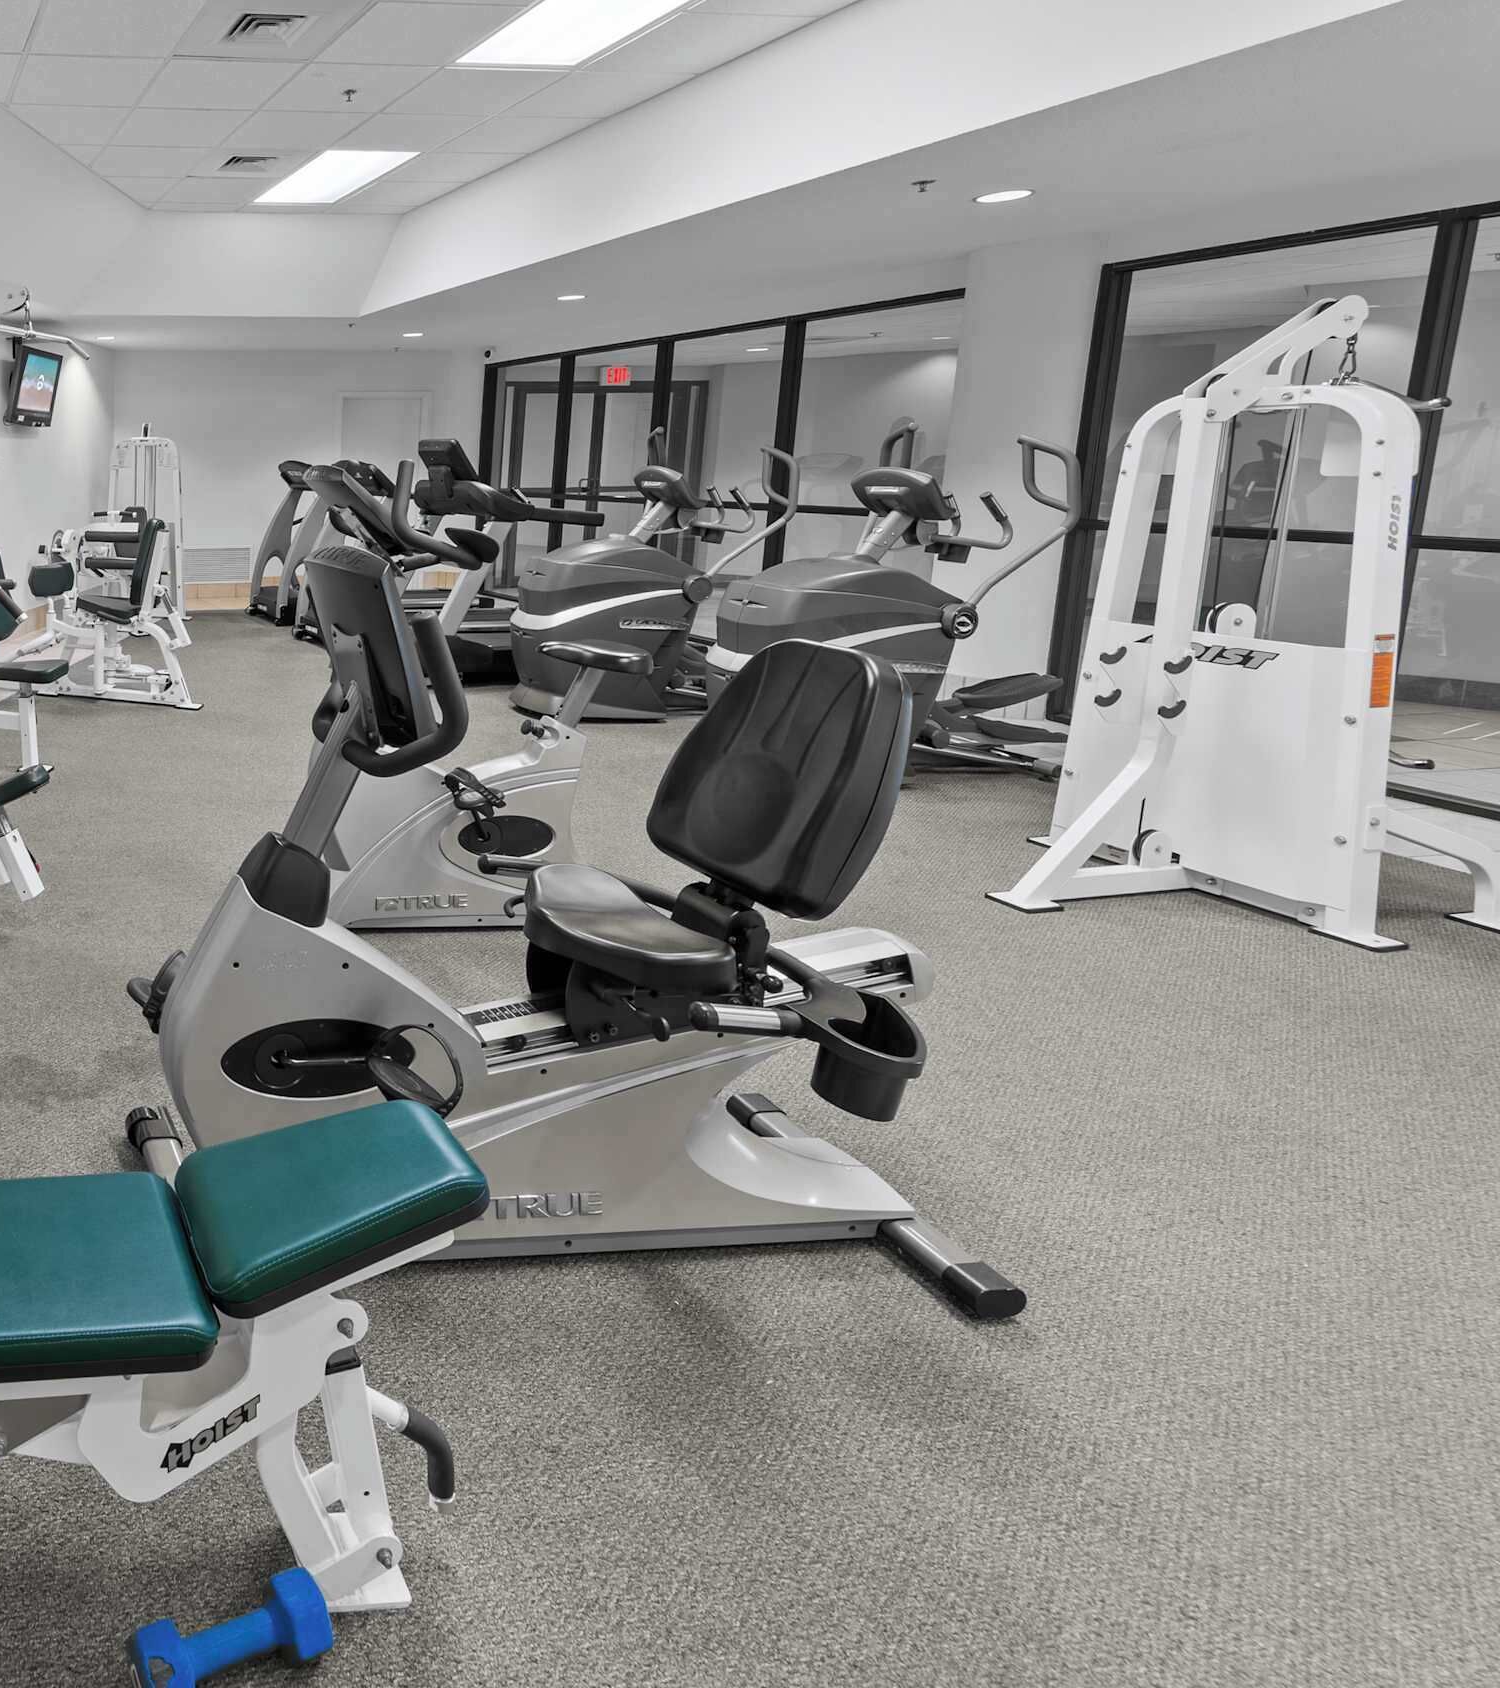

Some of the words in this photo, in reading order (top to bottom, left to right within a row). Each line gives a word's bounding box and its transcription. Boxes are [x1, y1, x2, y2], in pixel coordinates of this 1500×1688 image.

[606, 367, 628, 384] EXIT
[1387, 495, 1402, 551] HOIST
[489, 1190, 604, 1220] TRUE
[160, 1393, 261, 1473] HOIST
